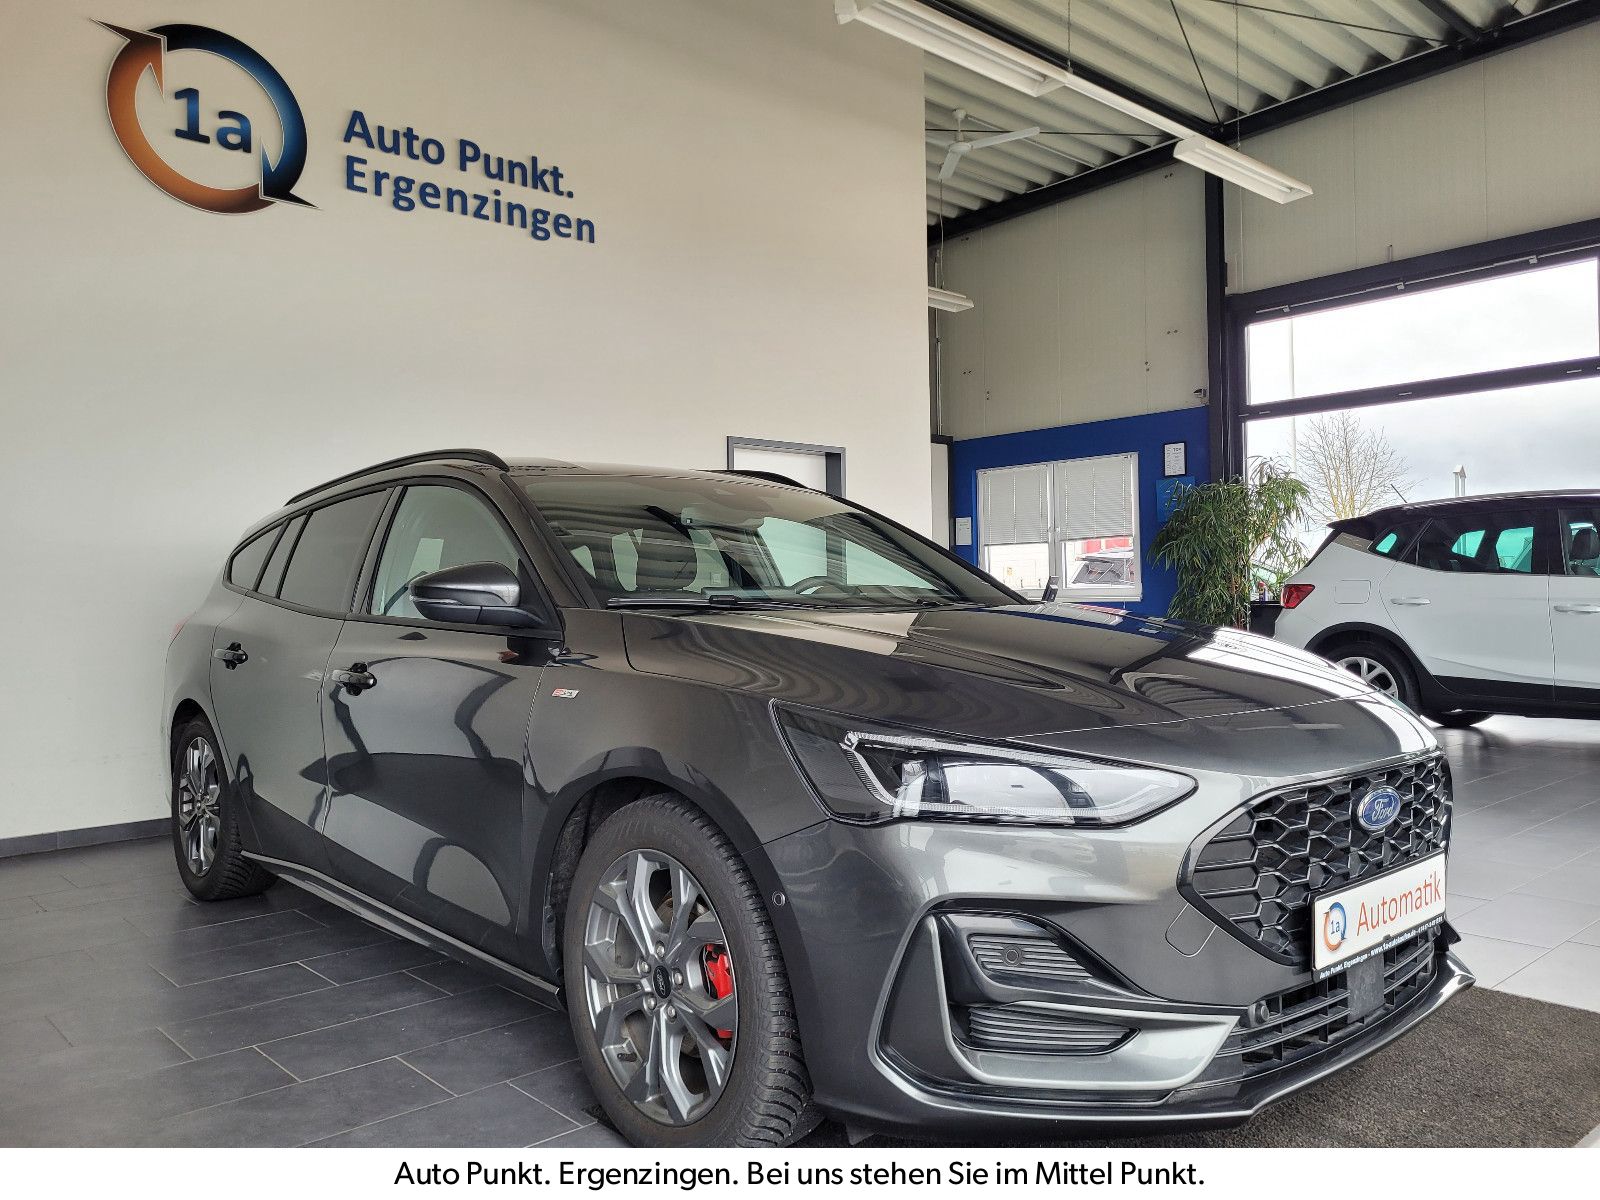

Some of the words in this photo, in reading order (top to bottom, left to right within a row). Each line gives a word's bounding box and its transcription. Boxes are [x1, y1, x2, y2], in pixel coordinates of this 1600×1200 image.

[174, 87, 252, 154] 1a
[343, 110, 446, 166] Auto
[459, 138, 575, 199] Punkt.
[346, 154, 596, 244] Ergenzingen
[1371, 796, 1395, 822] Ford
[1330, 920, 1341, 935] 1a
[1356, 870, 1441, 937] Automatik
